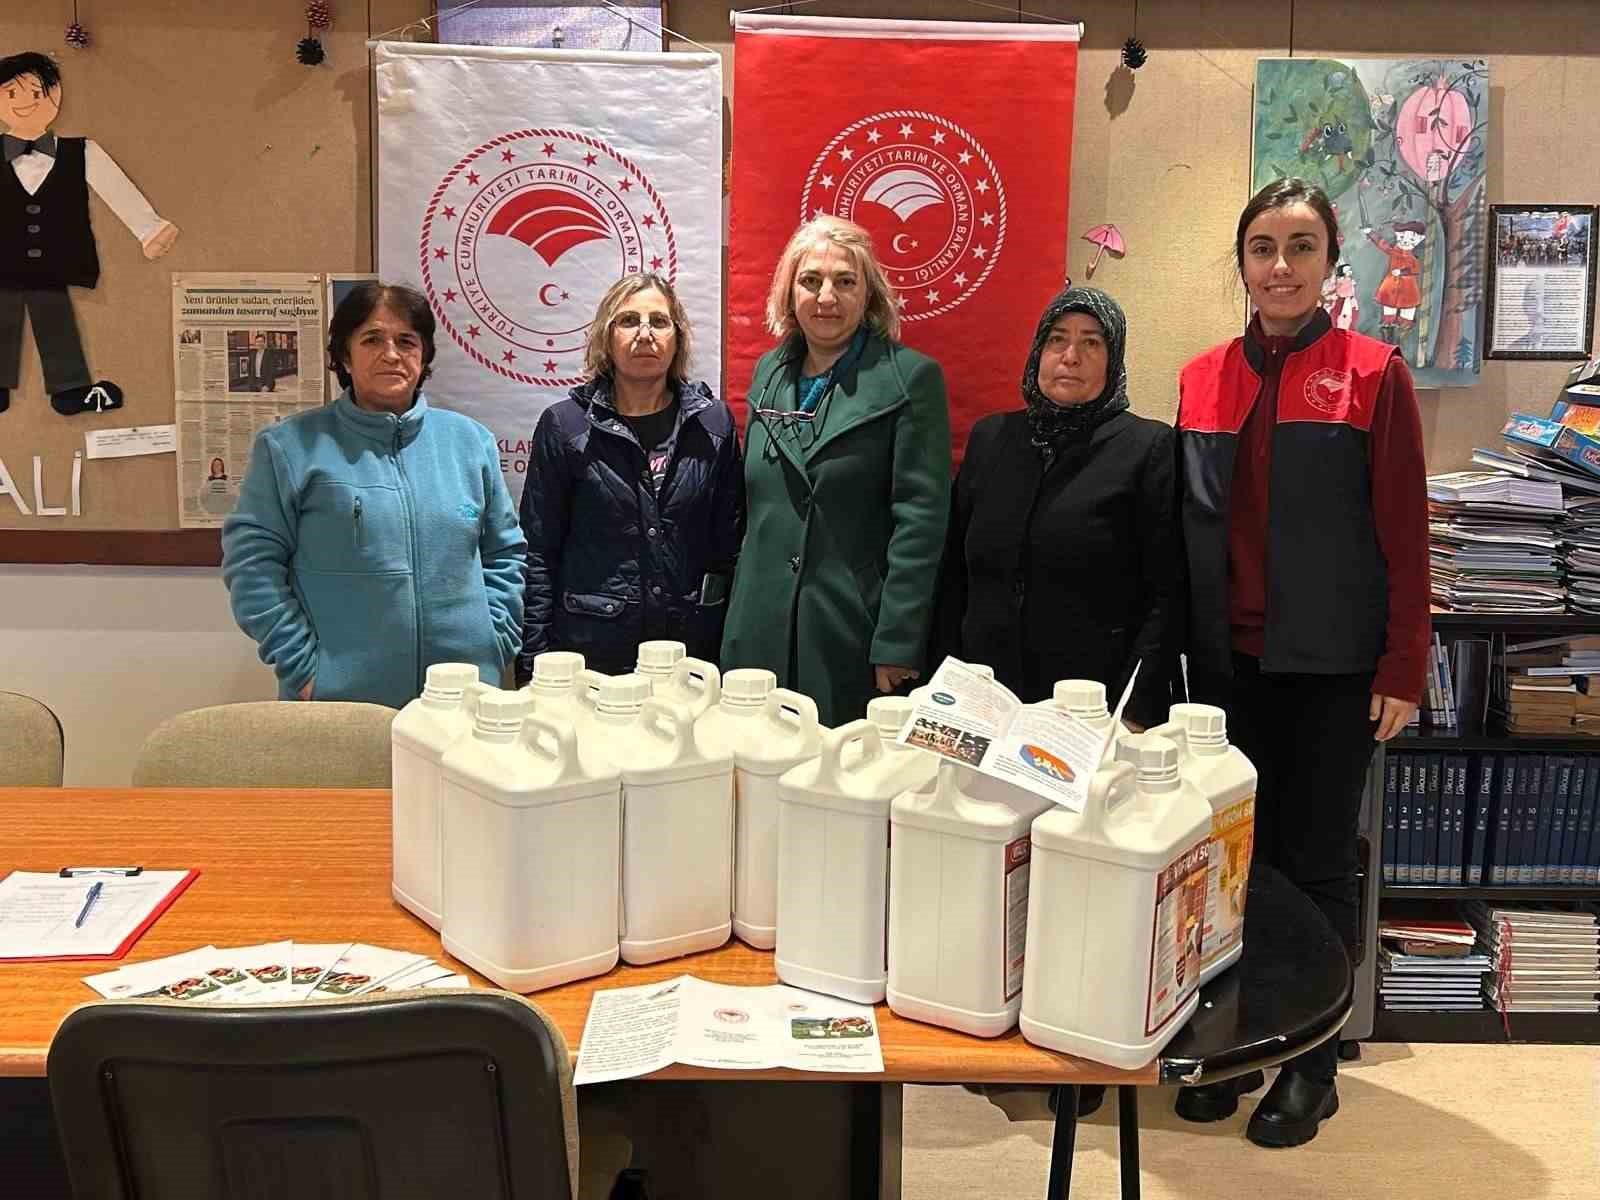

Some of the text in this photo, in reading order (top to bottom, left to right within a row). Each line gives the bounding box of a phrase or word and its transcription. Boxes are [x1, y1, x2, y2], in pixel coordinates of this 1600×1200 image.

[461, 168, 637, 338] TÜRKİYE CUMHURİYETİ TARIM VE ORMAN
[839, 150, 969, 281] MHURİYETİ TARIM VE ORMAN BAKANLIĞI
